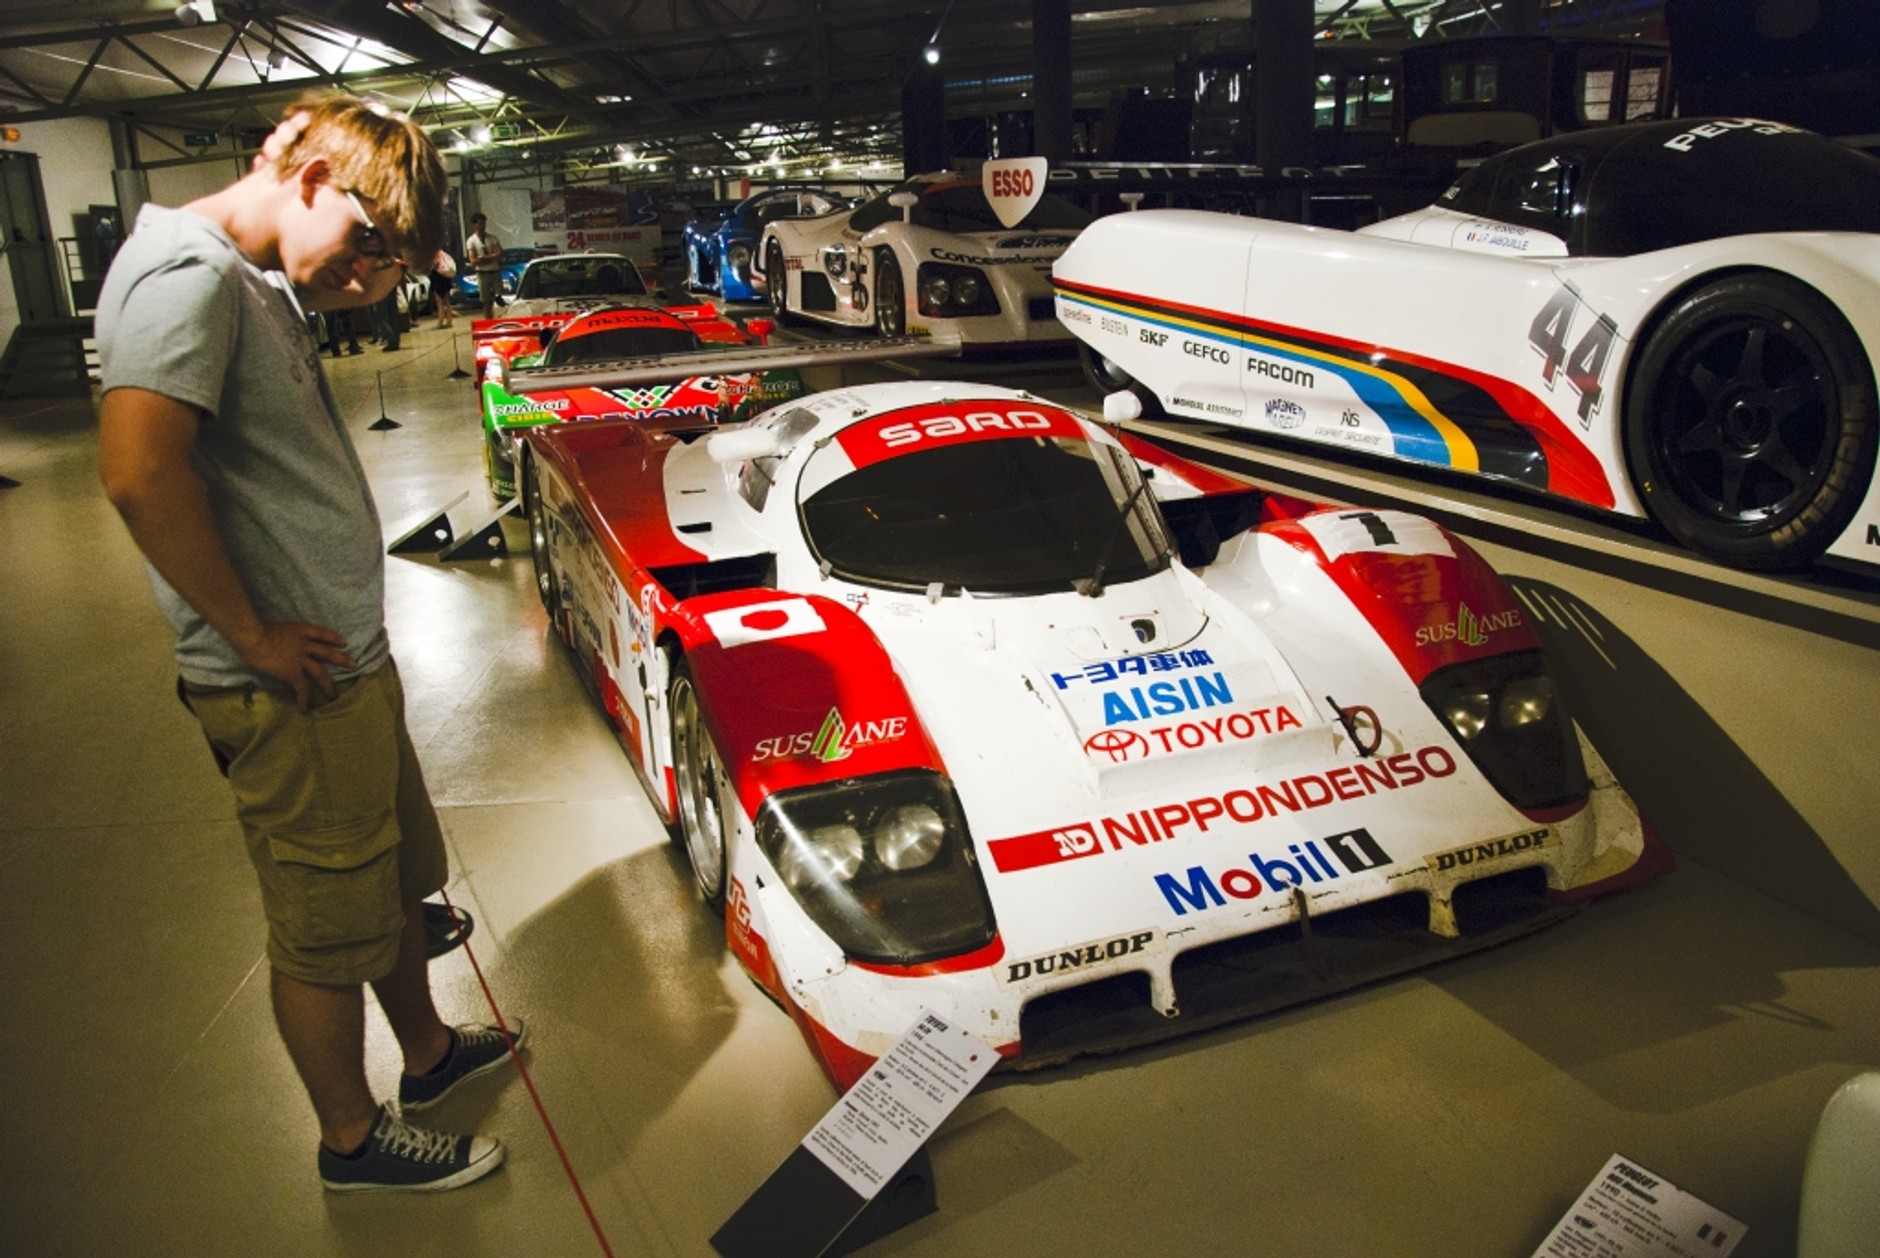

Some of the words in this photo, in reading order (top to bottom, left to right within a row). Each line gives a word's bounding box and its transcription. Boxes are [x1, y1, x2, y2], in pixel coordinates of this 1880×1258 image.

[992, 169, 1034, 197] ESSO
[567, 231, 585, 250] 24
[1139, 328, 1169, 348] SKF
[1183, 340, 1230, 365] GEFCO
[1528, 278, 1619, 431] 44
[1339, 512, 1399, 546] 1
[1051, 649, 1215, 690] トヨタ車体
[1103, 672, 1234, 726] AISIN
[1150, 705, 1303, 752] TOYOTA
[1101, 745, 1458, 851] NIPPONDENSO
[1436, 829, 1549, 871] DUNLOP
[1153, 841, 1340, 916] Mobil
[1007, 931, 1153, 983] DUNLOP
[1613, 1162, 1660, 1190] PEUGEOT
